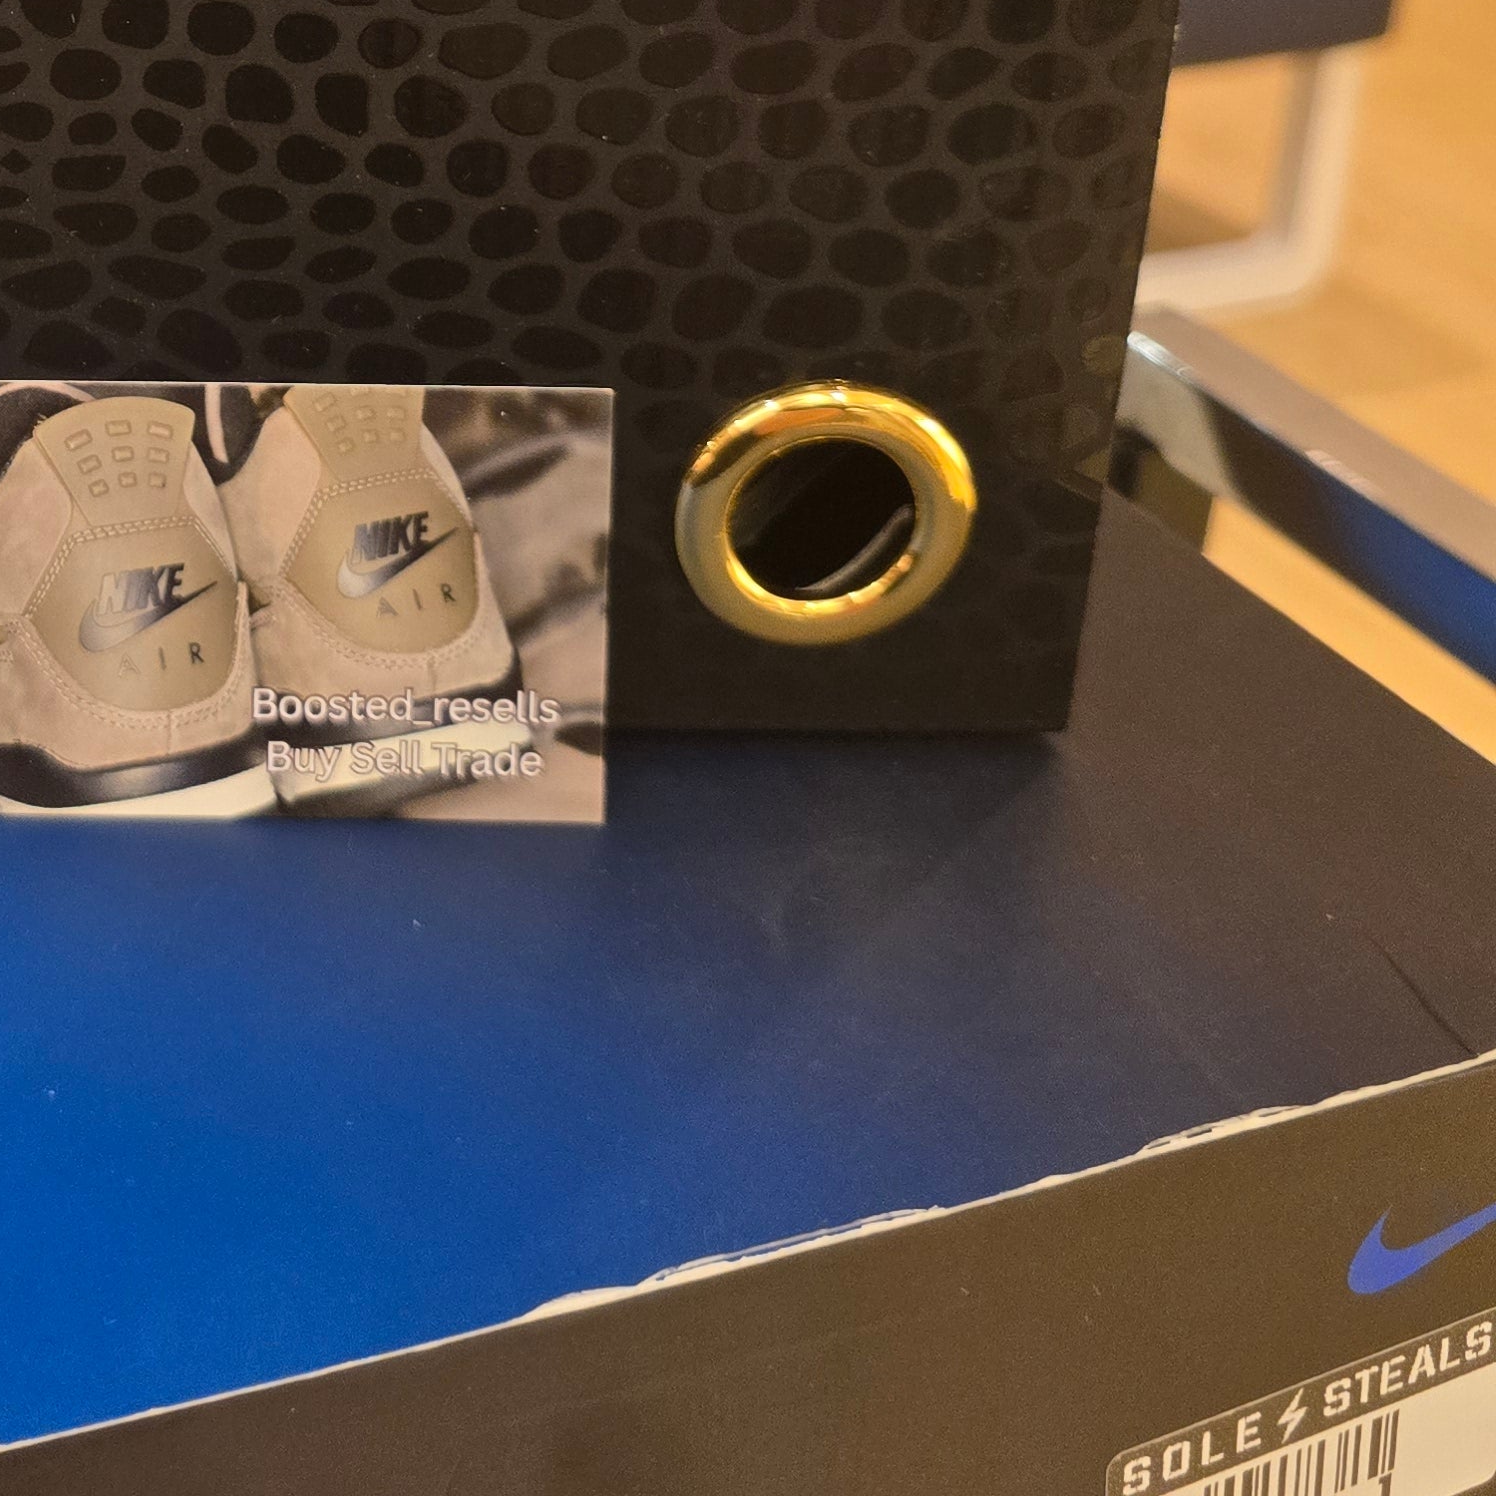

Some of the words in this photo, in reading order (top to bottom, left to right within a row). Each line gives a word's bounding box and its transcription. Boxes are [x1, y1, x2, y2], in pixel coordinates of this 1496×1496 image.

[351, 511, 430, 565] NIKE
[98, 562, 185, 617] NIKE
[376, 583, 456, 618] AIR
[252, 687, 561, 726] Boosted_resells
[267, 740, 342, 783] Buy
[350, 739, 424, 775] Sell
[432, 741, 546, 778] Trade
[1122, 1412, 1262, 1496] SOLE
[1323, 1320, 1494, 1418] STEALS
